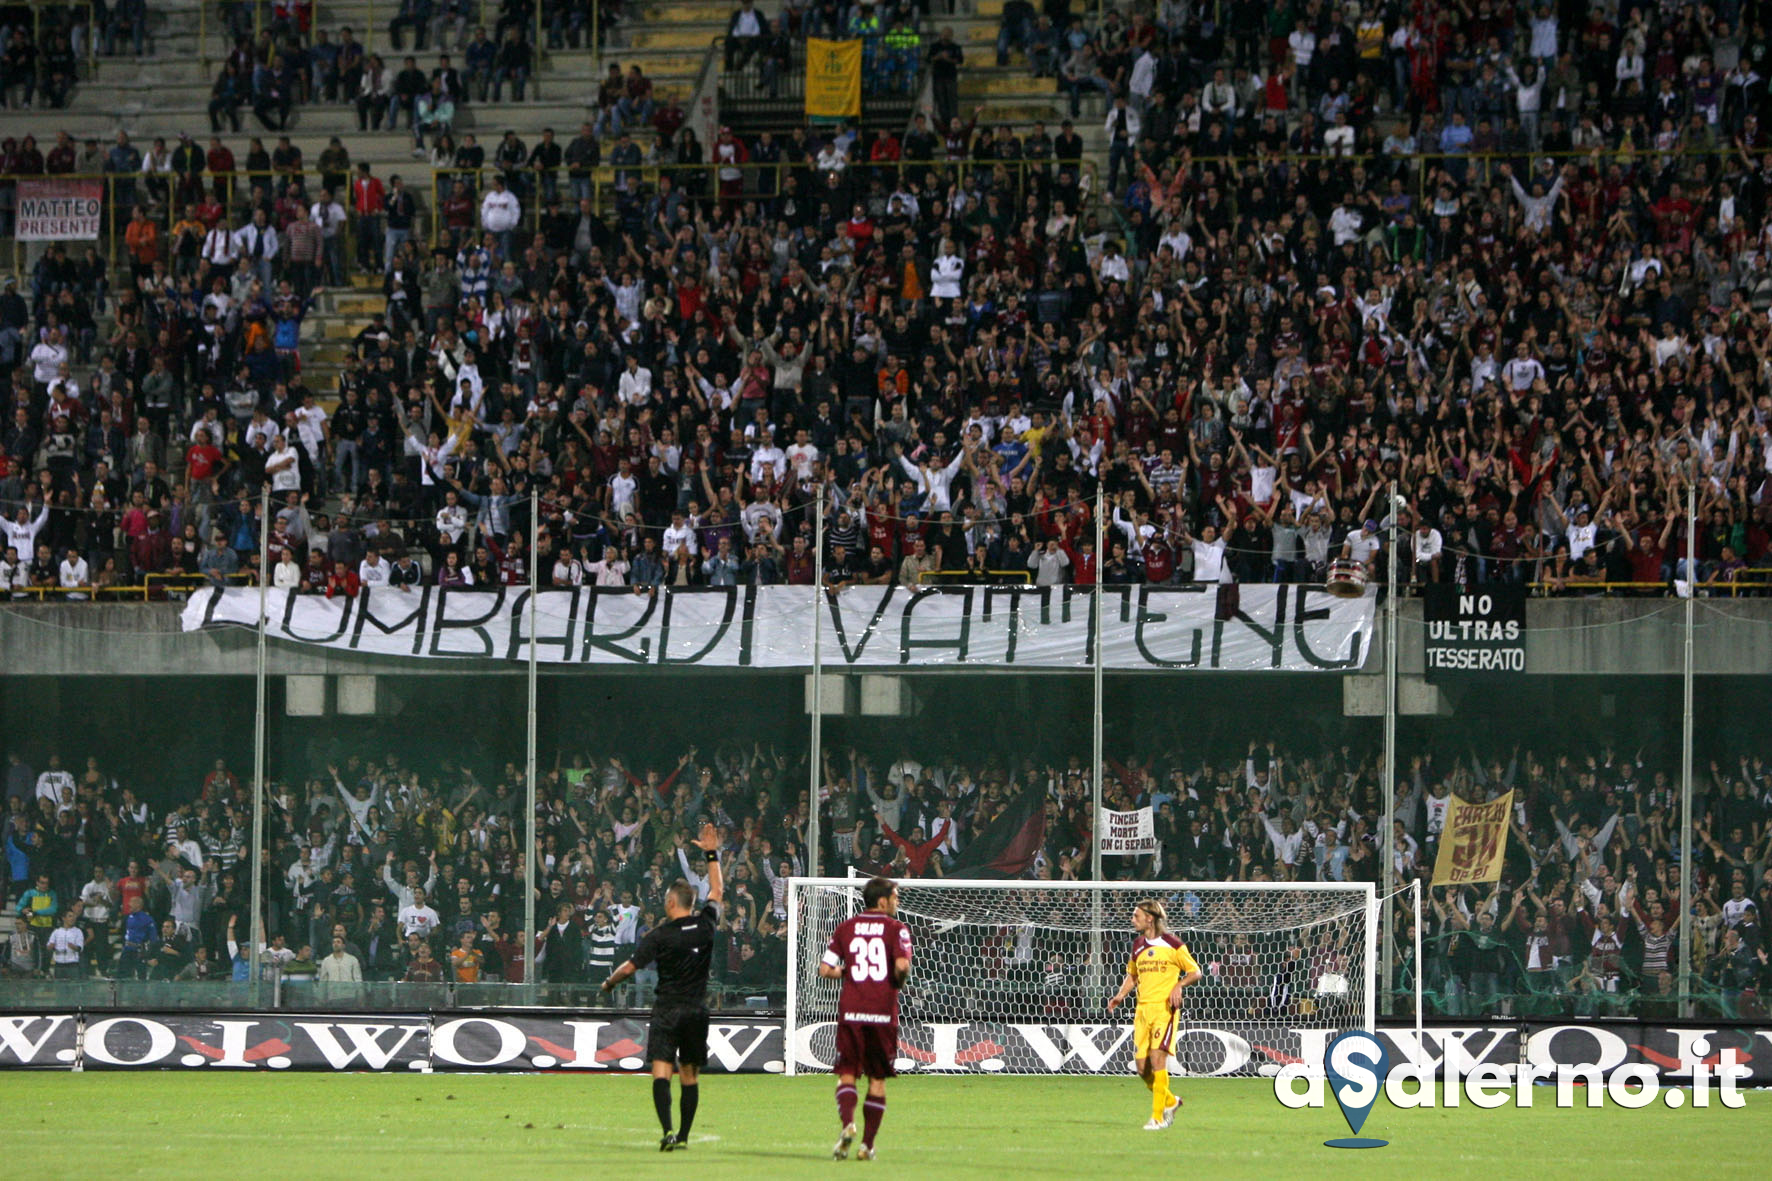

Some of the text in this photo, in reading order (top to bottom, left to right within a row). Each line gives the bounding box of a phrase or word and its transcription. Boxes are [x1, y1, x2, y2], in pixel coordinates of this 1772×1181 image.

[21, 199, 99, 218] MATTEO
[20, 219, 98, 235] PRESENTE
[1459, 594, 1492, 615] NO
[202, 585, 1359, 668] LOMBARDI VATTENE
[1429, 620, 1520, 641] ULTRAS
[1426, 647, 1525, 671] TESSERATO
[1109, 812, 1139, 825] FINCHE
[1110, 826, 1138, 838] MORTE
[1114, 839, 1123, 850] CI
[1124, 837, 1154, 850] SEPARI
[849, 937, 888, 981] 39
